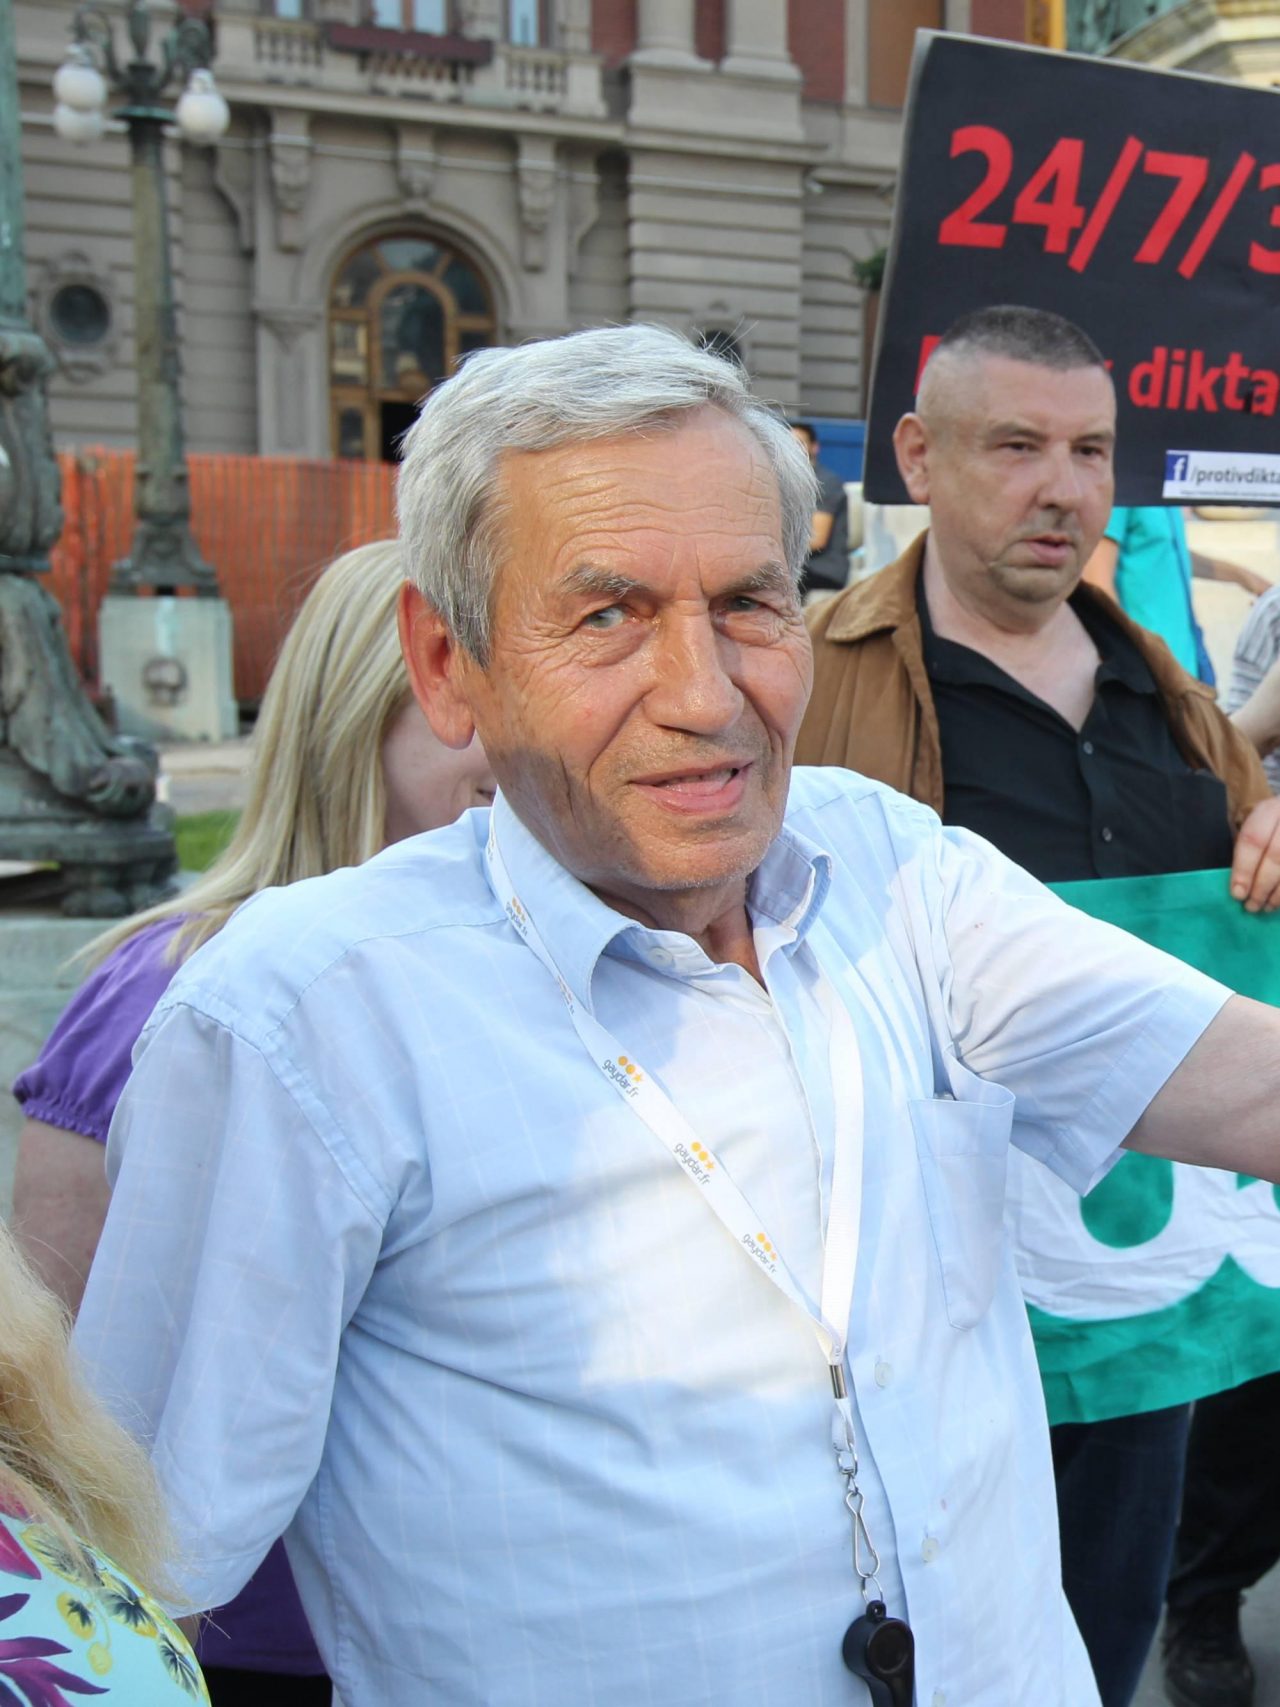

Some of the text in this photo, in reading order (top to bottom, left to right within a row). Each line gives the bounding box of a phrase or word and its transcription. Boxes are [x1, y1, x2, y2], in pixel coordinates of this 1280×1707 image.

[602, 1059, 639, 1098] gaydar.fr
[674, 1143, 710, 1185] gaydar.fr
[742, 1233, 777, 1274] gaydar.fr
